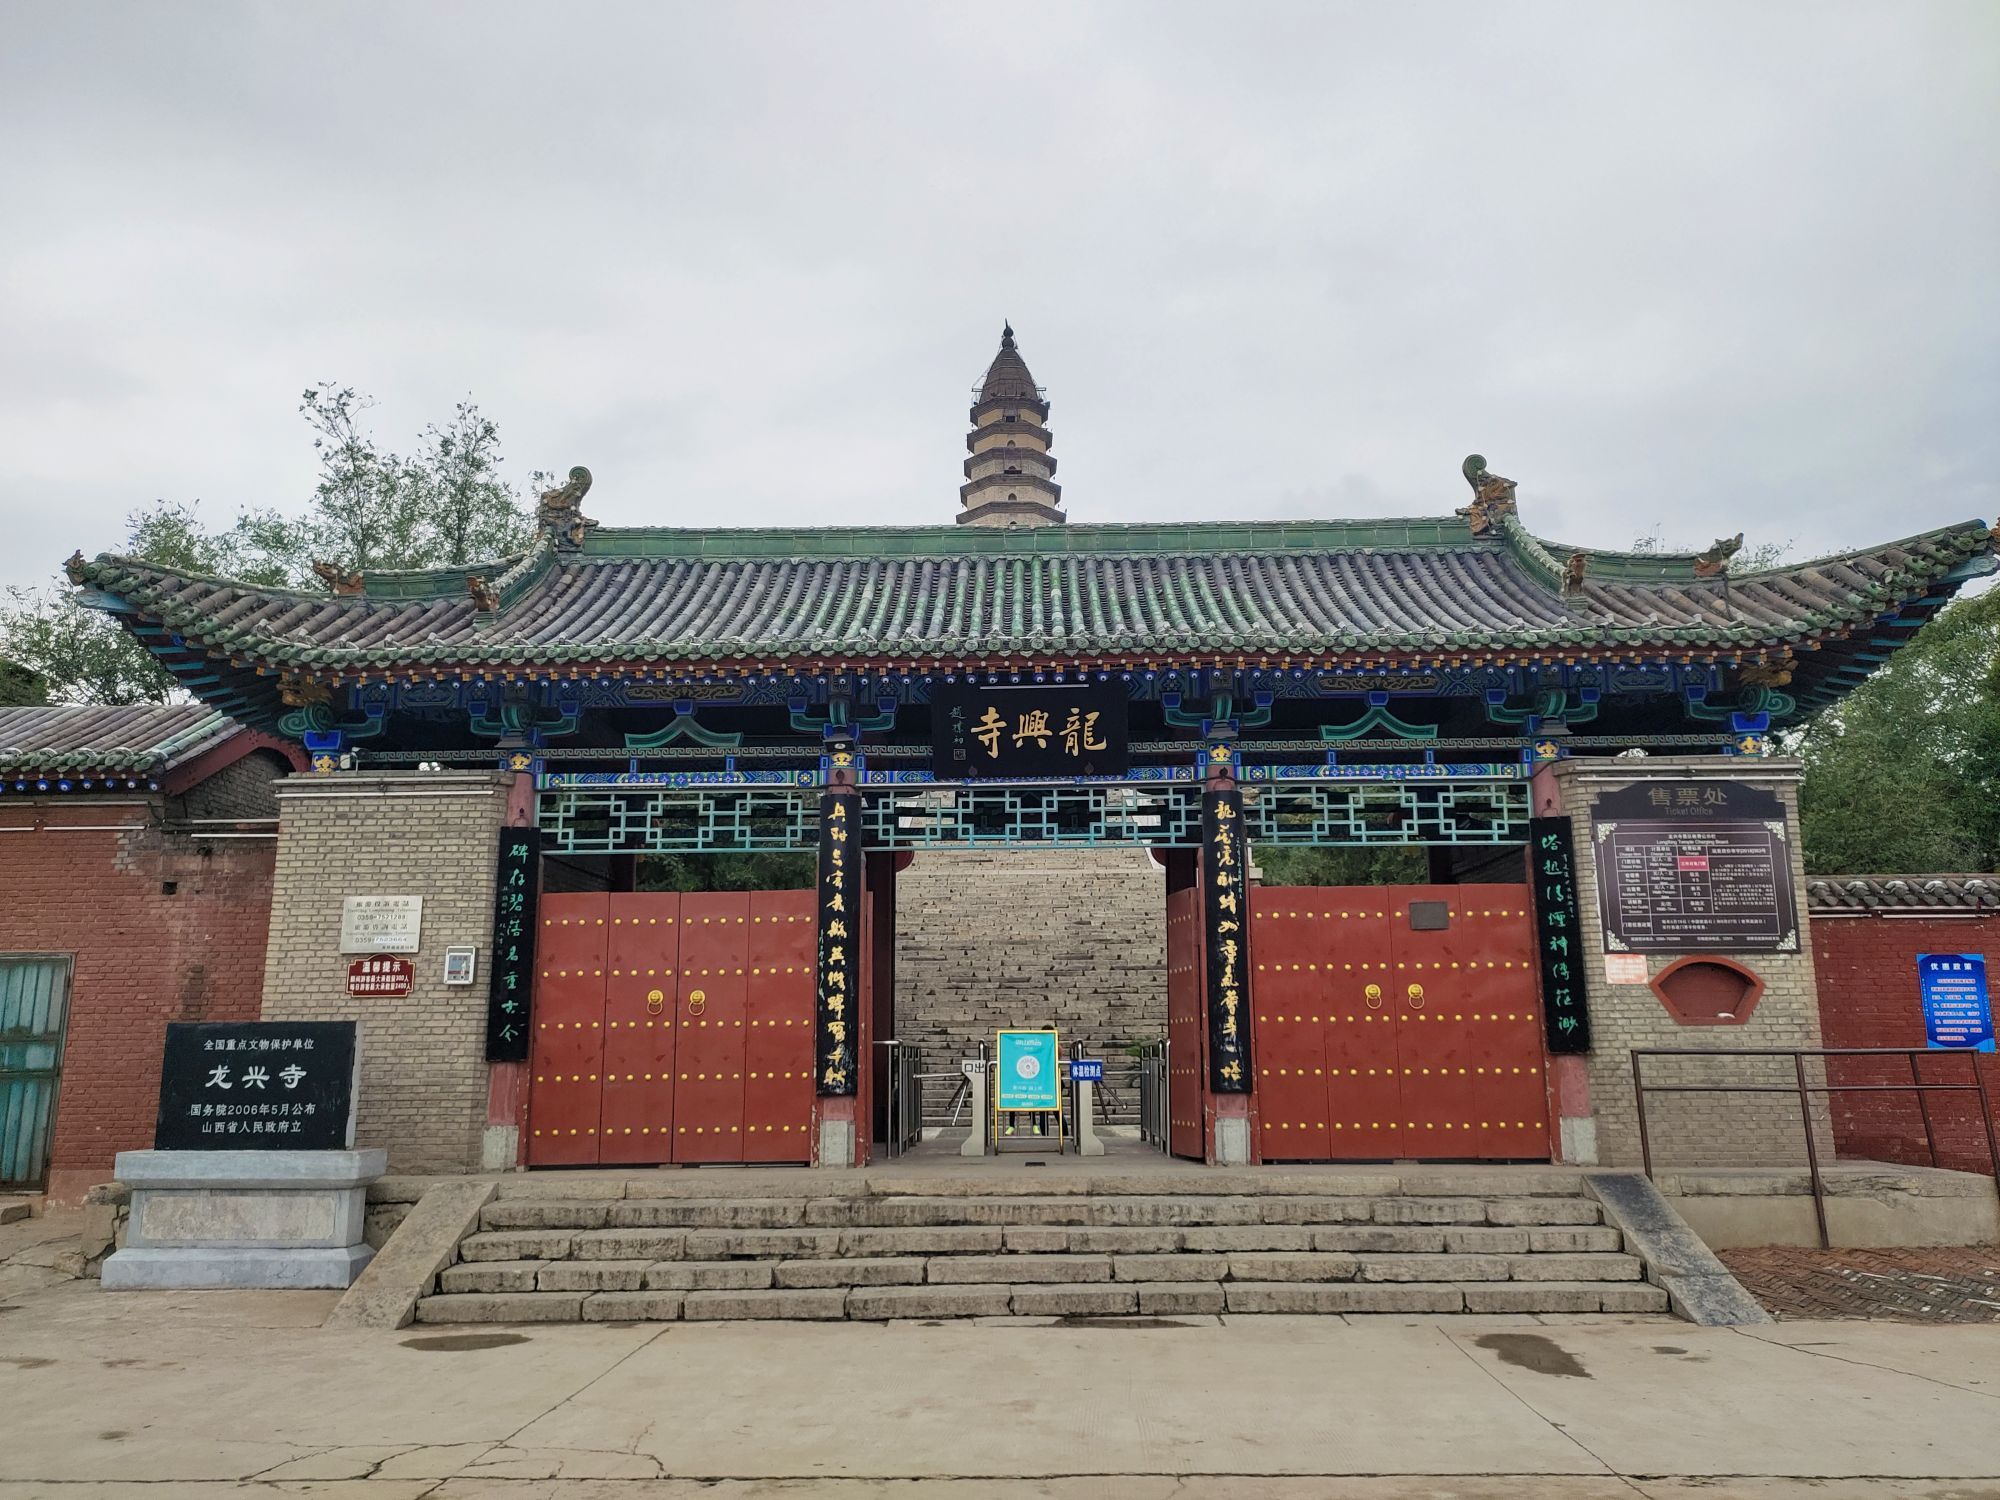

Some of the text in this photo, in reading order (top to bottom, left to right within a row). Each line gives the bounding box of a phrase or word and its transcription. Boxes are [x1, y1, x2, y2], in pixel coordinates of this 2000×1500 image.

[970, 706, 1108, 759] 龍興寺
[1648, 787, 1728, 805] 售票处
[1664, 806, 1713, 816] Ticket Office
[362, 961, 401, 973] 温馨提示
[204, 1038, 314, 1051] 全国重点文物保护单位
[204, 1063, 308, 1090] 龙兴寺
[1072, 1065, 1101, 1078] 体温检测点
[190, 1103, 316, 1116] 国务院2006年5月公布
[202, 1120, 302, 1134] 山西省人民政府立
